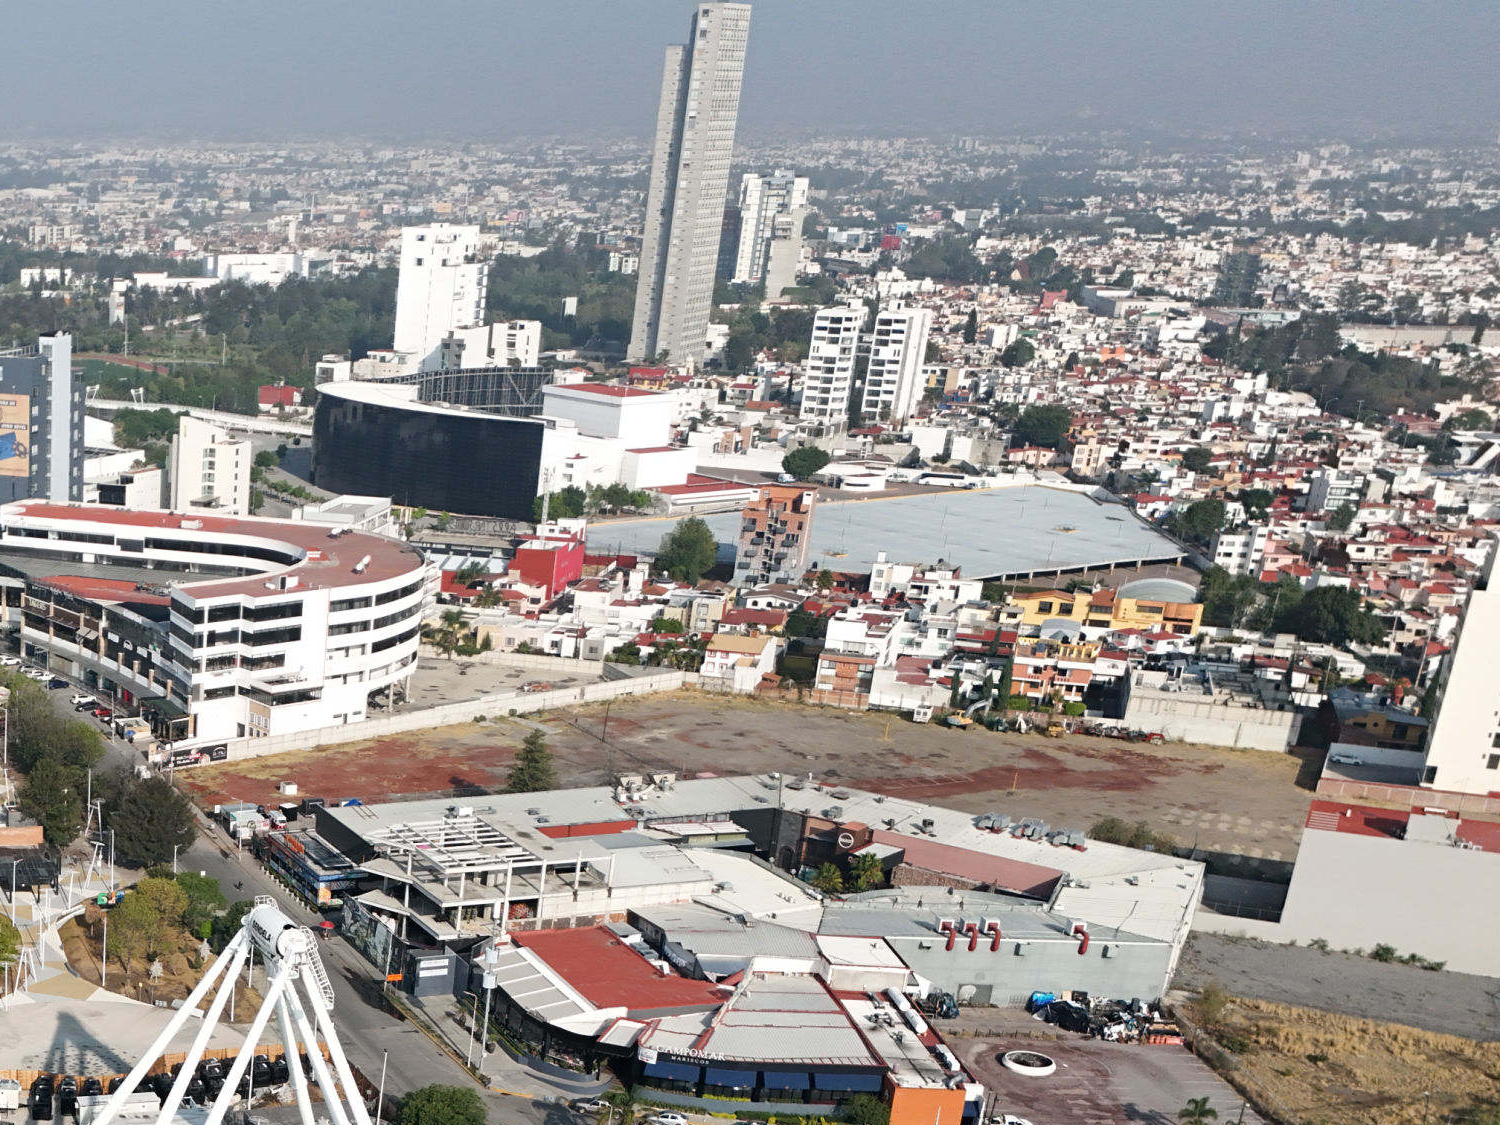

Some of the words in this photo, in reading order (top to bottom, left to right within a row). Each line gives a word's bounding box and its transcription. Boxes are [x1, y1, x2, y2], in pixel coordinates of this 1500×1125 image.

[251, 919, 272, 942] SENDELA
[656, 1044, 727, 1062] CAMPOMAR
[670, 1055, 710, 1065] MARISCOS
